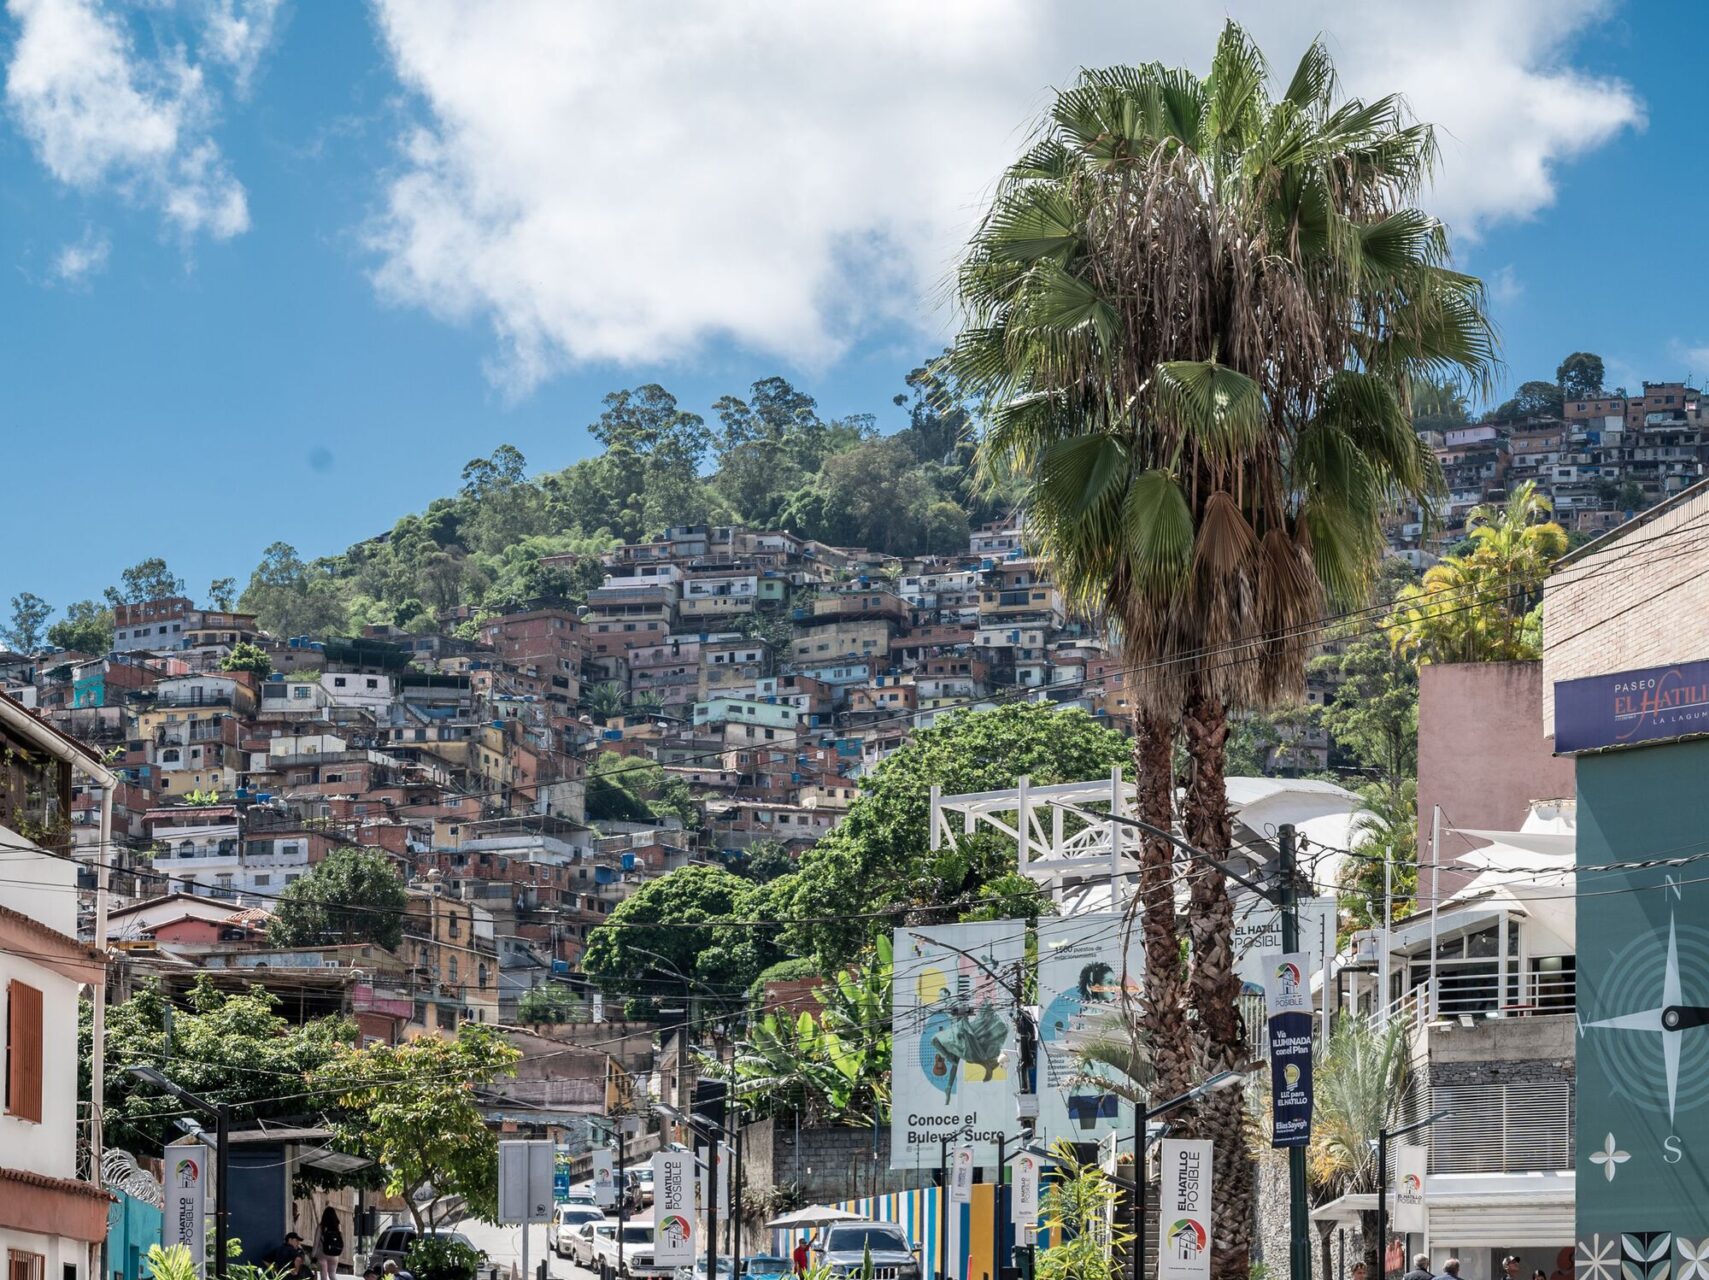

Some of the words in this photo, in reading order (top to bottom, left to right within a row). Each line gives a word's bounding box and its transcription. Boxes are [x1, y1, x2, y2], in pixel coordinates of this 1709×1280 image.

[1614, 679, 1656, 694] PASEO
[1614, 695, 1637, 714] EL
[1653, 717, 1665, 725] LA
[1665, 873, 1682, 902] N
[1234, 926, 1247, 936] EL
[1234, 934, 1283, 949] POSIBL
[1292, 1045, 1309, 1055] Plan
[907, 1113, 960, 1127] Conoce
[964, 1111, 977, 1125] el
[1662, 1135, 1683, 1164] S
[664, 1161, 673, 1199] HATILLO
[1178, 1151, 1188, 1198] HATILLO
[1186, 1151, 1200, 1212] POSIBLE
[672, 1161, 682, 1210] POSIBLE
[664, 1200, 673, 1210] EL
[1177, 1198, 1187, 1211] EL
[185, 1197, 194, 1246] POSIBLE
